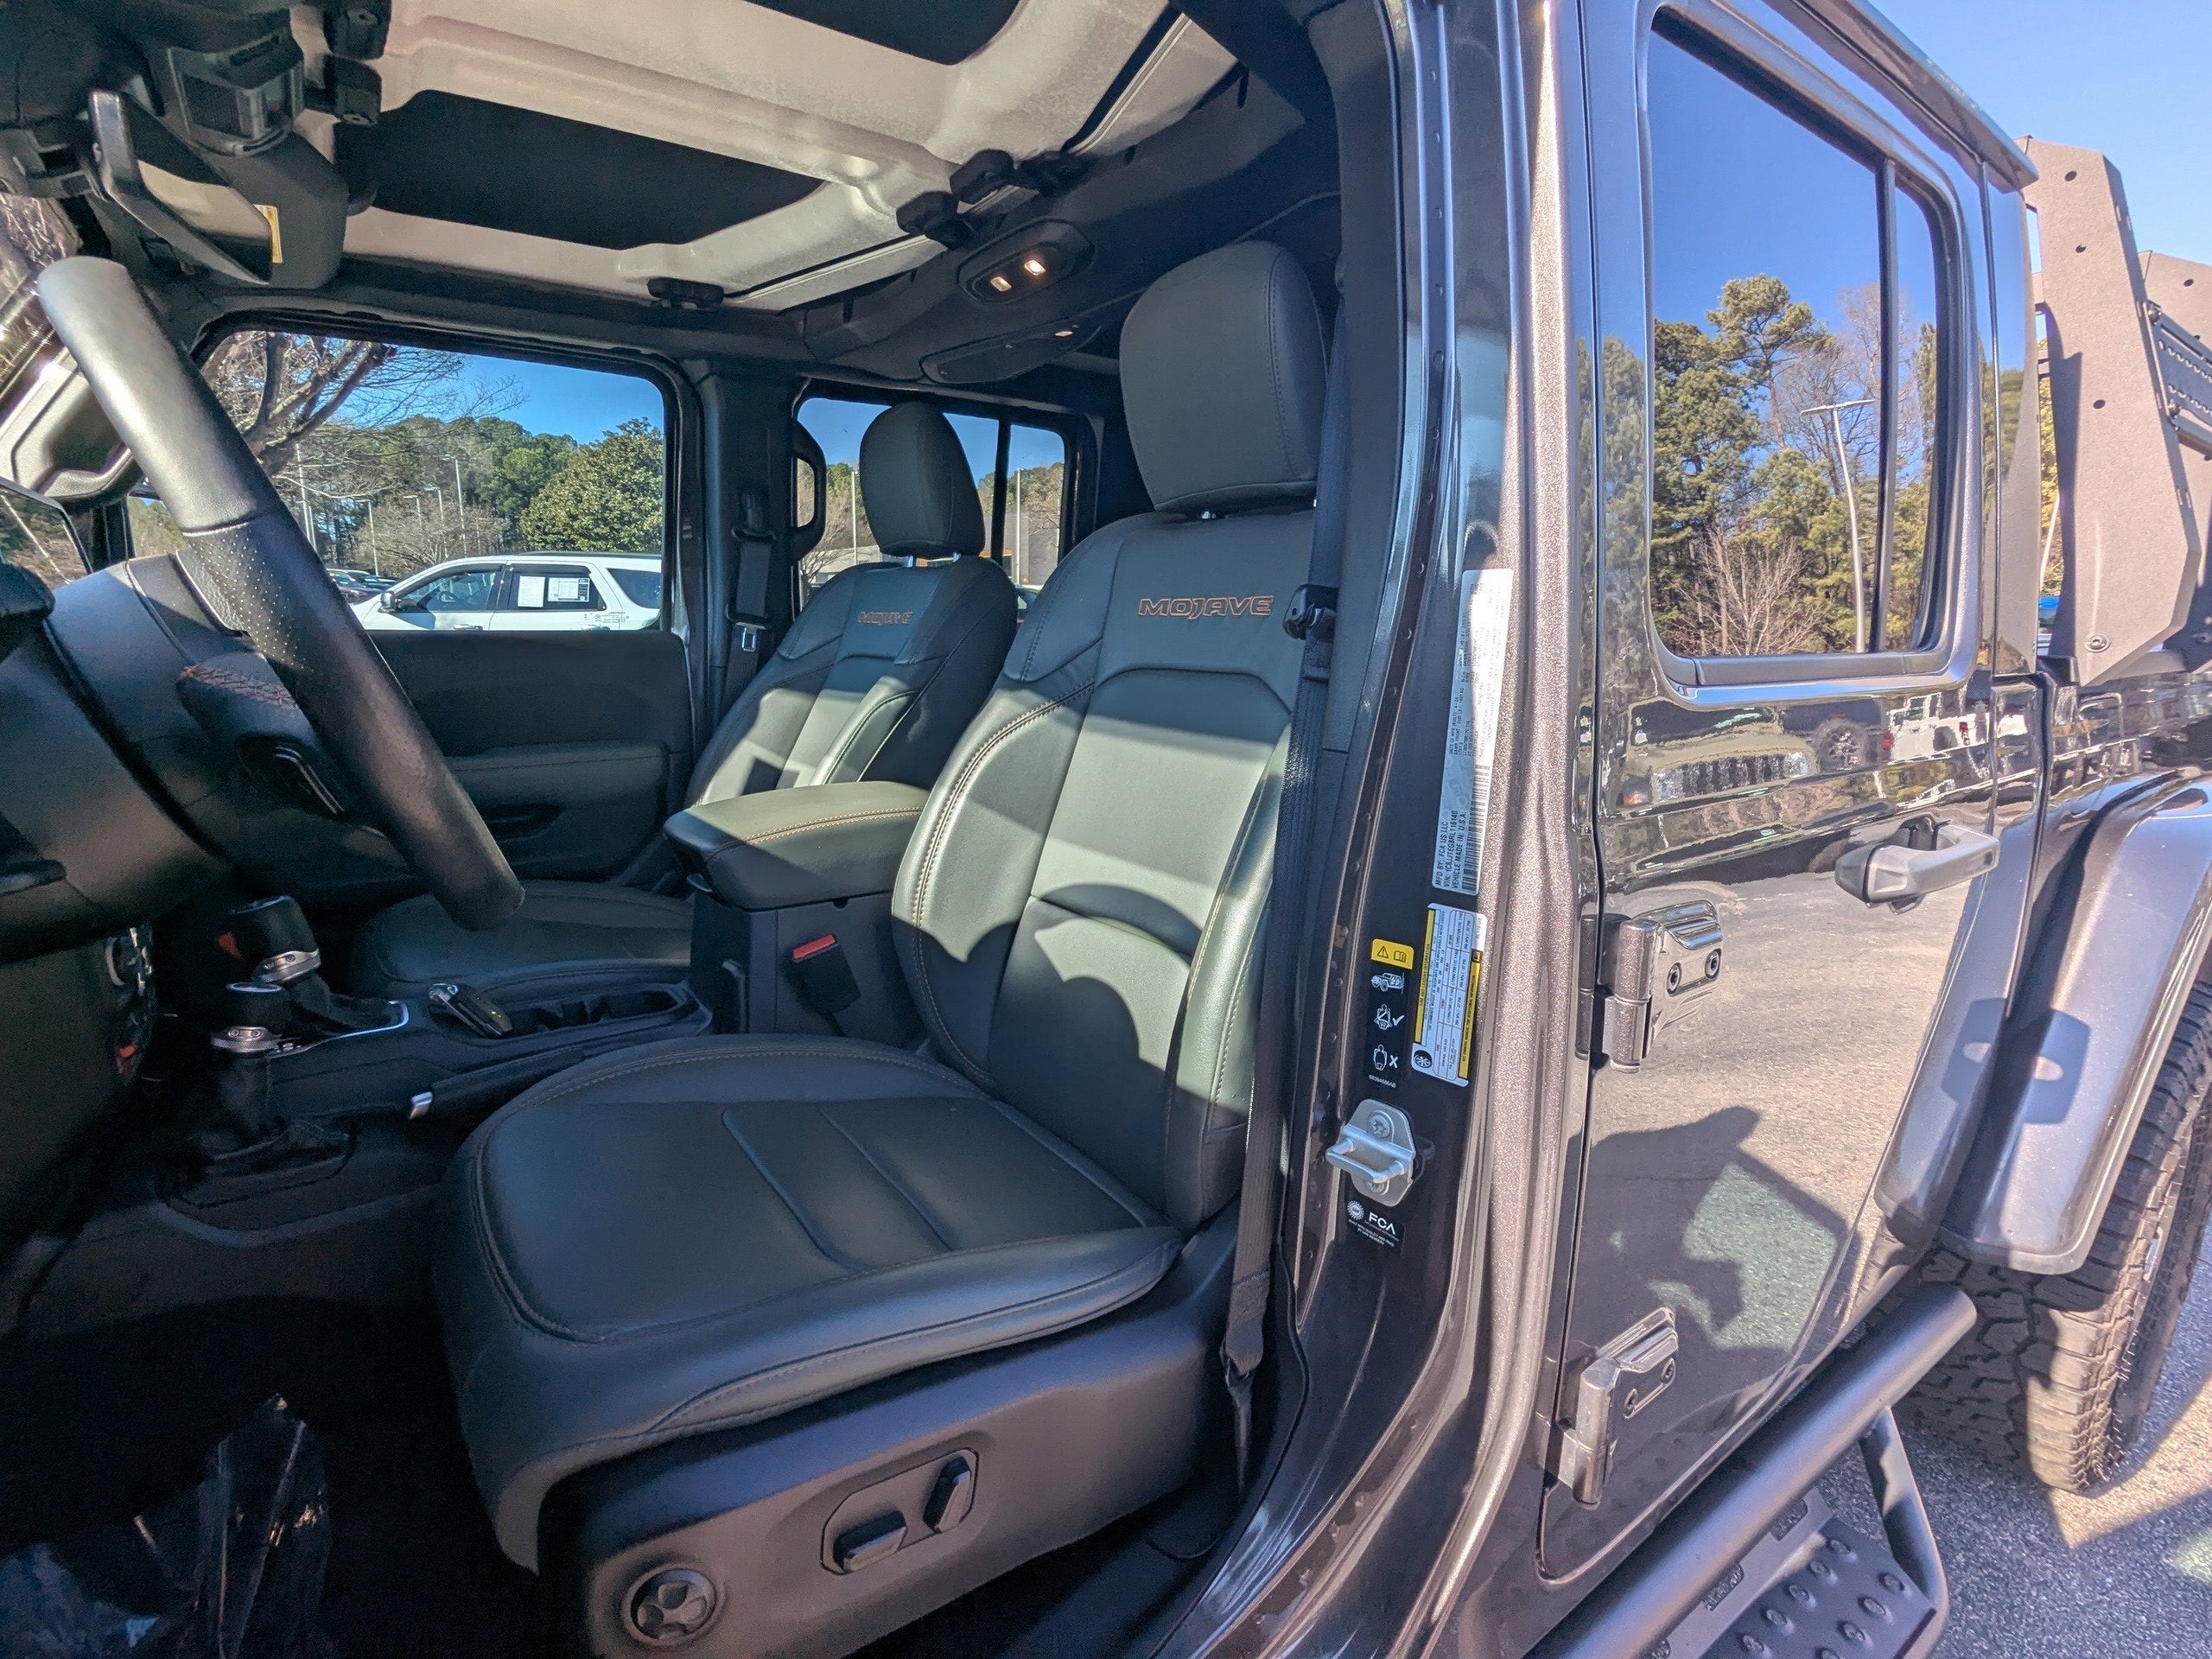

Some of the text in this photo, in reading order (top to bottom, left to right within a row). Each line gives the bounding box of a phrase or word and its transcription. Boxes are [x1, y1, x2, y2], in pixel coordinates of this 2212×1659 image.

[1137, 594, 1274, 620] MOJAVE
[857, 611, 913, 626] MOJAVE
[1457, 810, 1466, 831] U.S.A.
[1434, 820, 1448, 886] MFD BY: FCA US LLC
[1453, 842, 1463, 861] MADE
[1442, 874, 1452, 887] VIN:
[1451, 861, 1460, 889] VEHICLE
[1369, 1212, 1396, 1235] FCA
